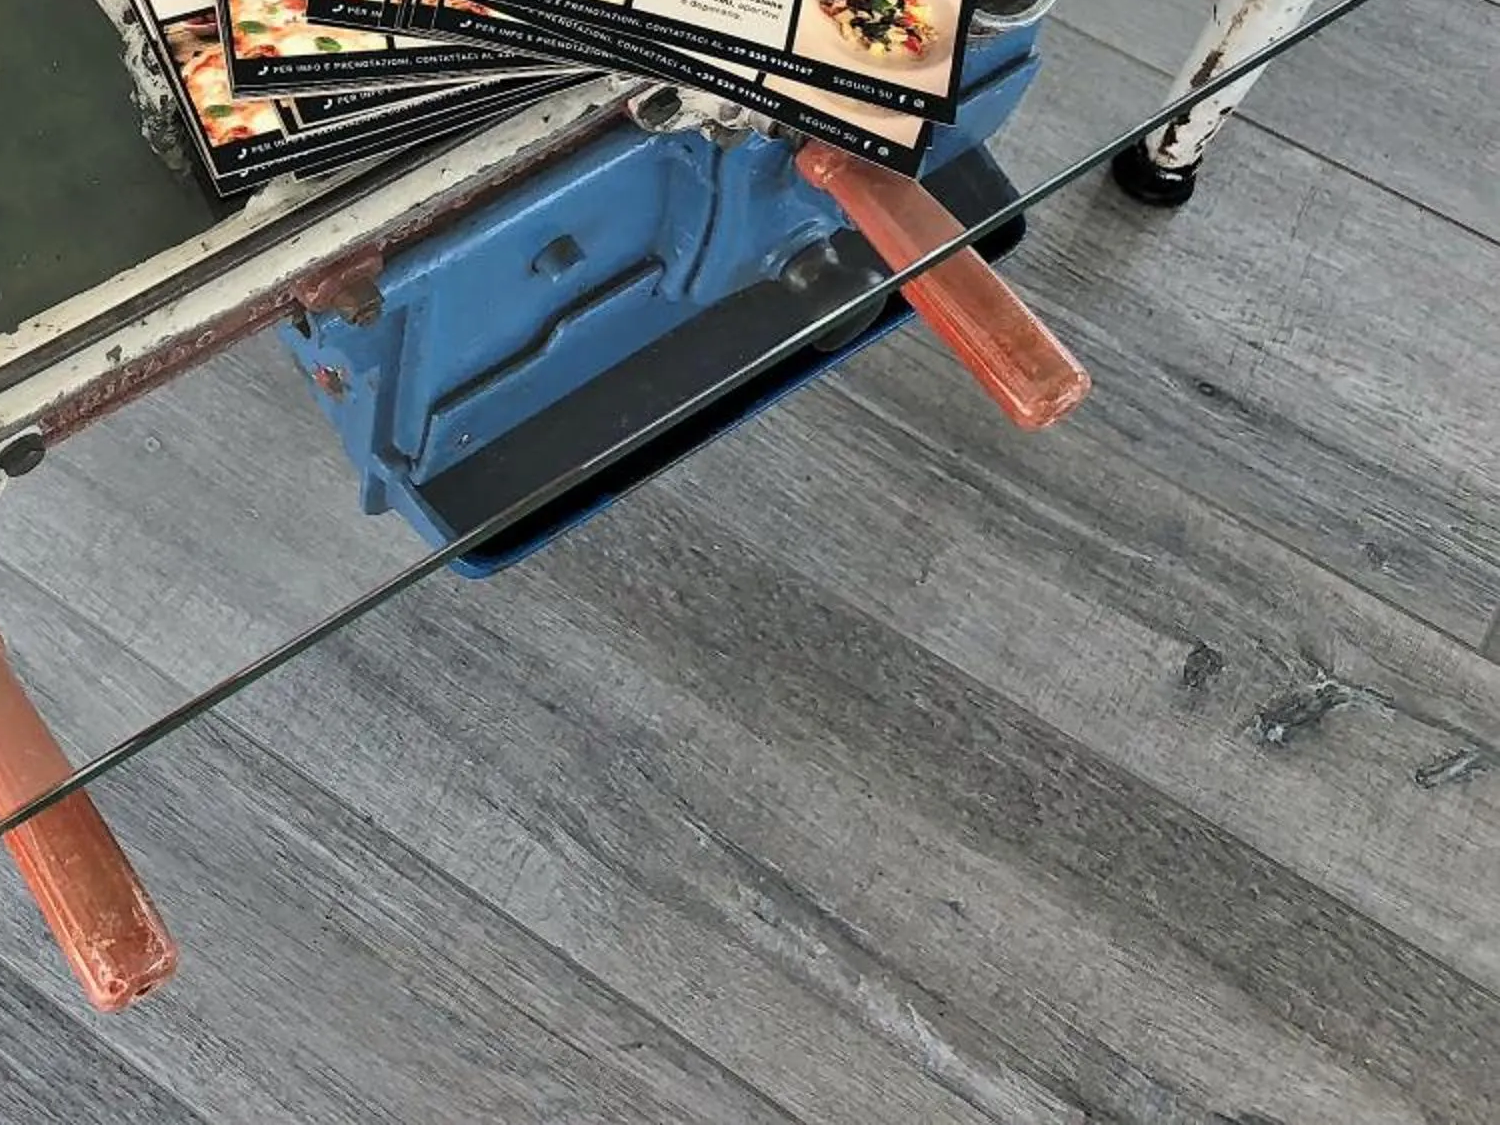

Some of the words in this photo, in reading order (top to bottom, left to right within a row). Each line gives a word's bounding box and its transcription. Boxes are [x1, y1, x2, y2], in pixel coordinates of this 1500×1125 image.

[347, 7, 367, 17] PER
[474, 21, 496, 35] PER
[498, 27, 523, 40] INFO
[644, 21, 709, 45] CONTATTACI
[710, 40, 724, 50] AL
[296, 64, 320, 72] INFO
[615, 39, 679, 67] CONTATTACI
[679, 64, 692, 74] AL
[831, 75, 875, 94] SEGUICI
[878, 90, 892, 100] SU
[796, 112, 843, 136] SEGUICI
